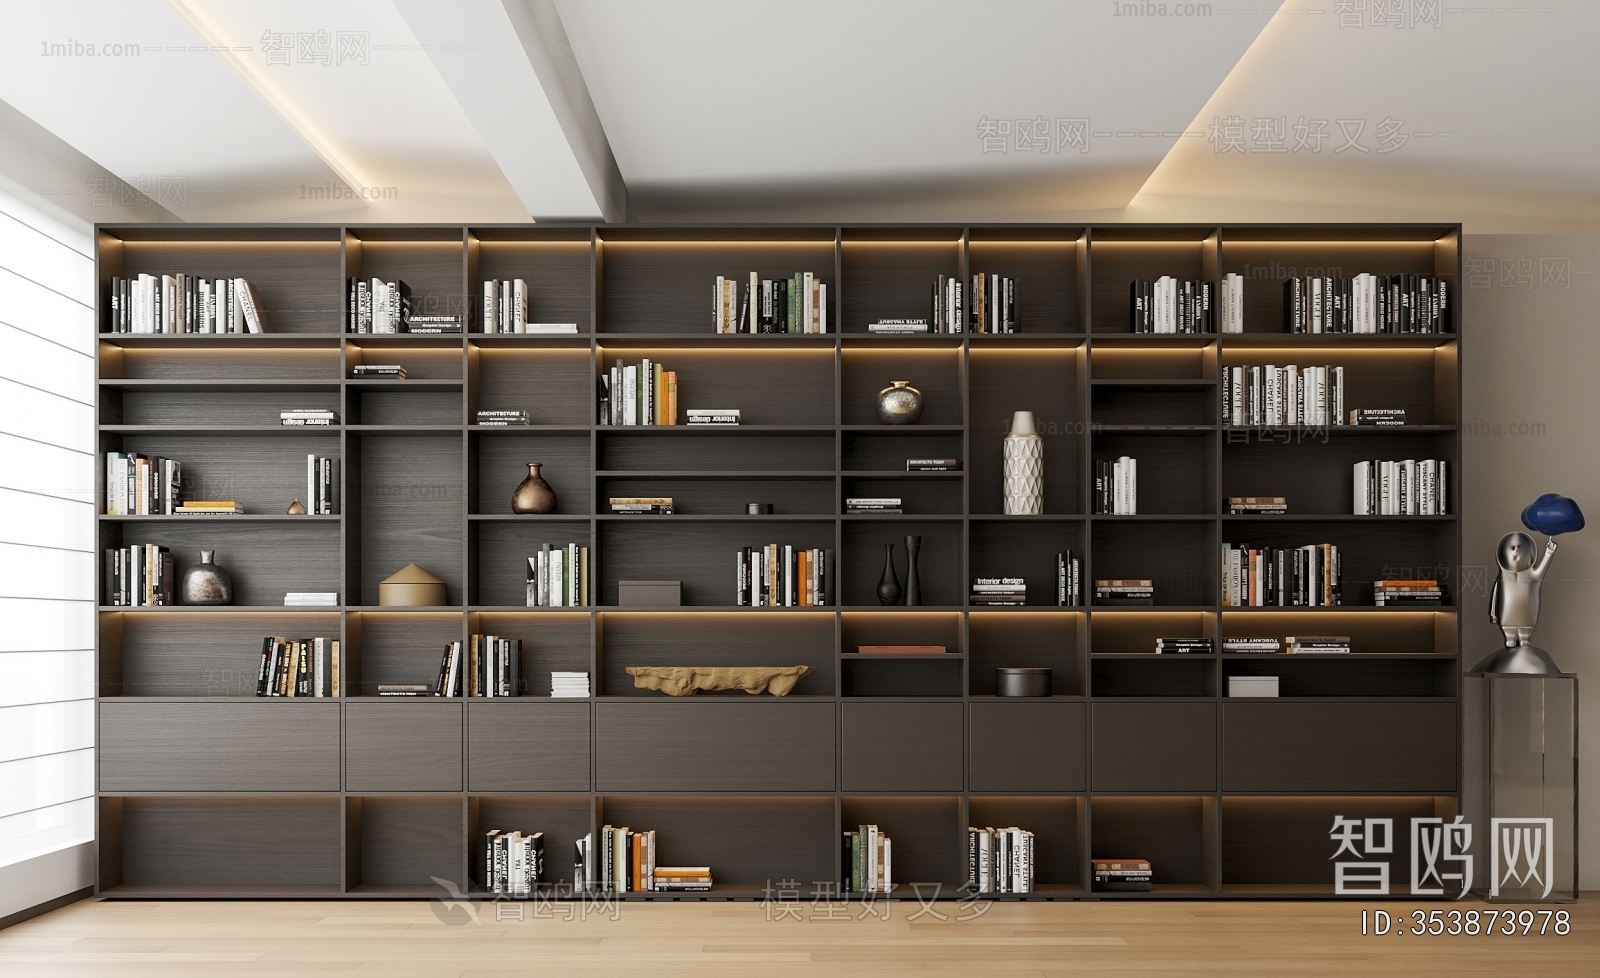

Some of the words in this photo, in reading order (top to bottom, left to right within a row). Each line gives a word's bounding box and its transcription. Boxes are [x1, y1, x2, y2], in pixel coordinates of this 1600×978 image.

[240, 291, 253, 322] CHANEL
[977, 577, 1001, 585] Interior
[1002, 577, 1024, 585] design
